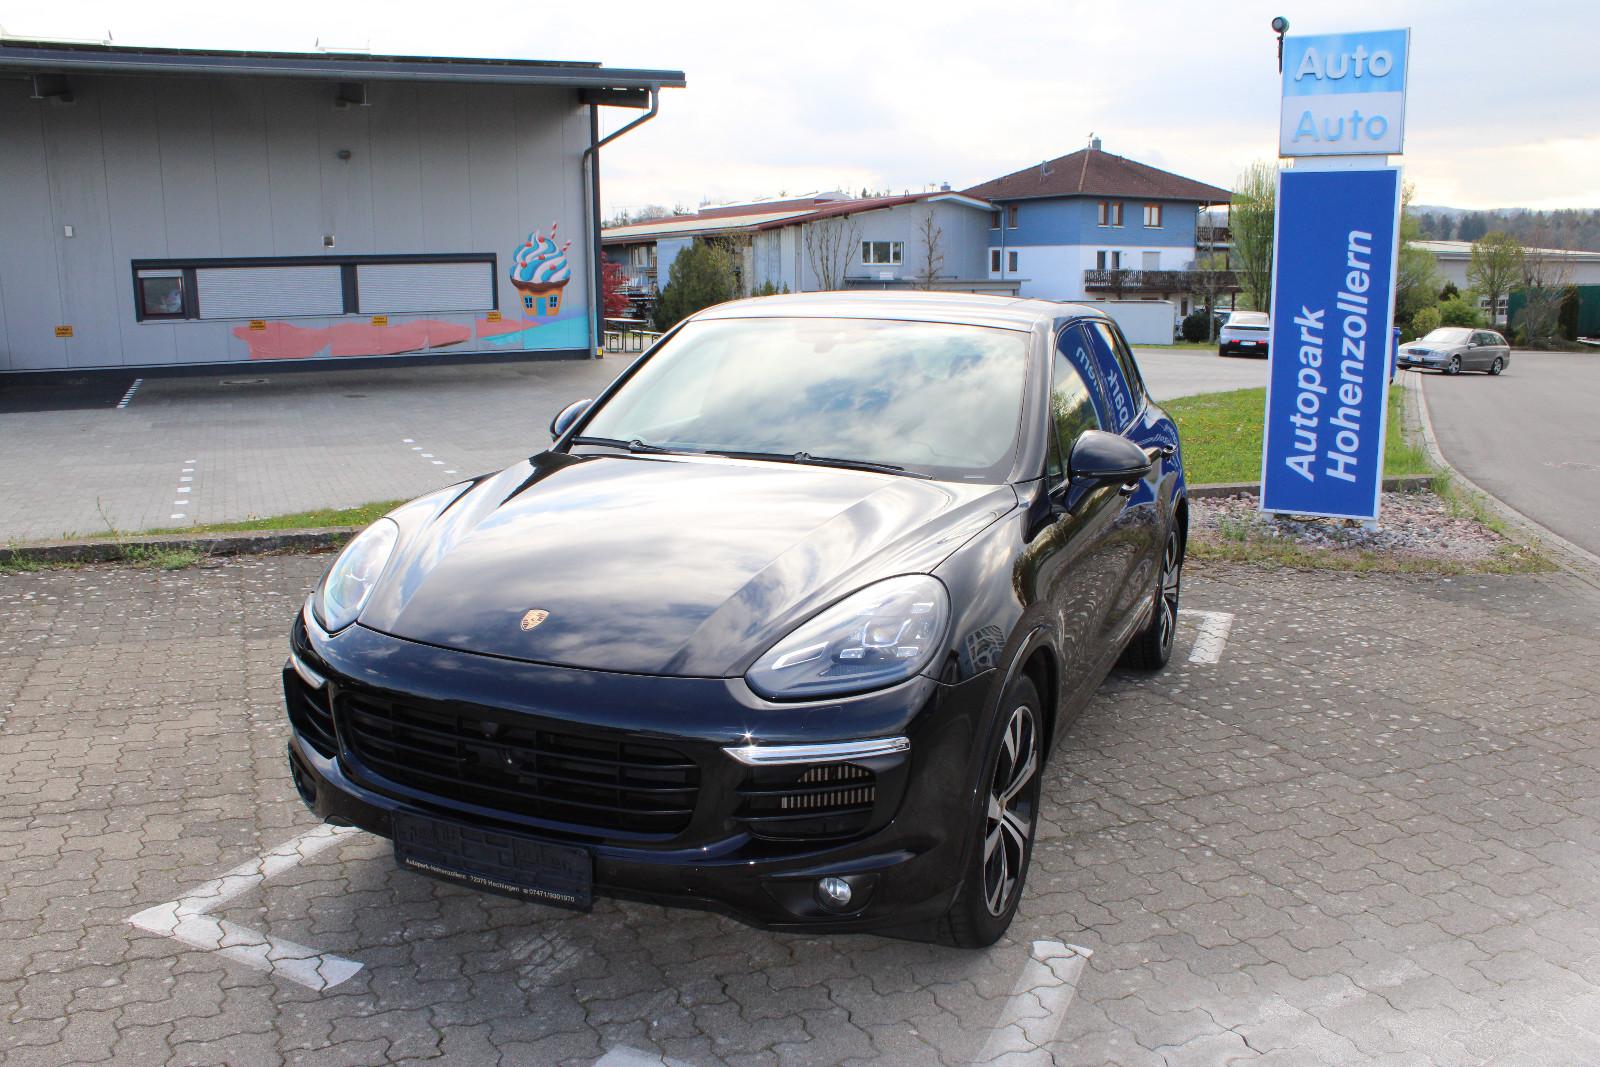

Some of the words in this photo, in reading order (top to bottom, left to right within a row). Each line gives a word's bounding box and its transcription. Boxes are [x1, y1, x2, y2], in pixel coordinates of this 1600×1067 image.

[1294, 45, 1393, 82] Auto
[1291, 109, 1389, 143] Auto
[1285, 304, 1328, 483] Autopark
[1325, 229, 1373, 483] Hohenzollern
